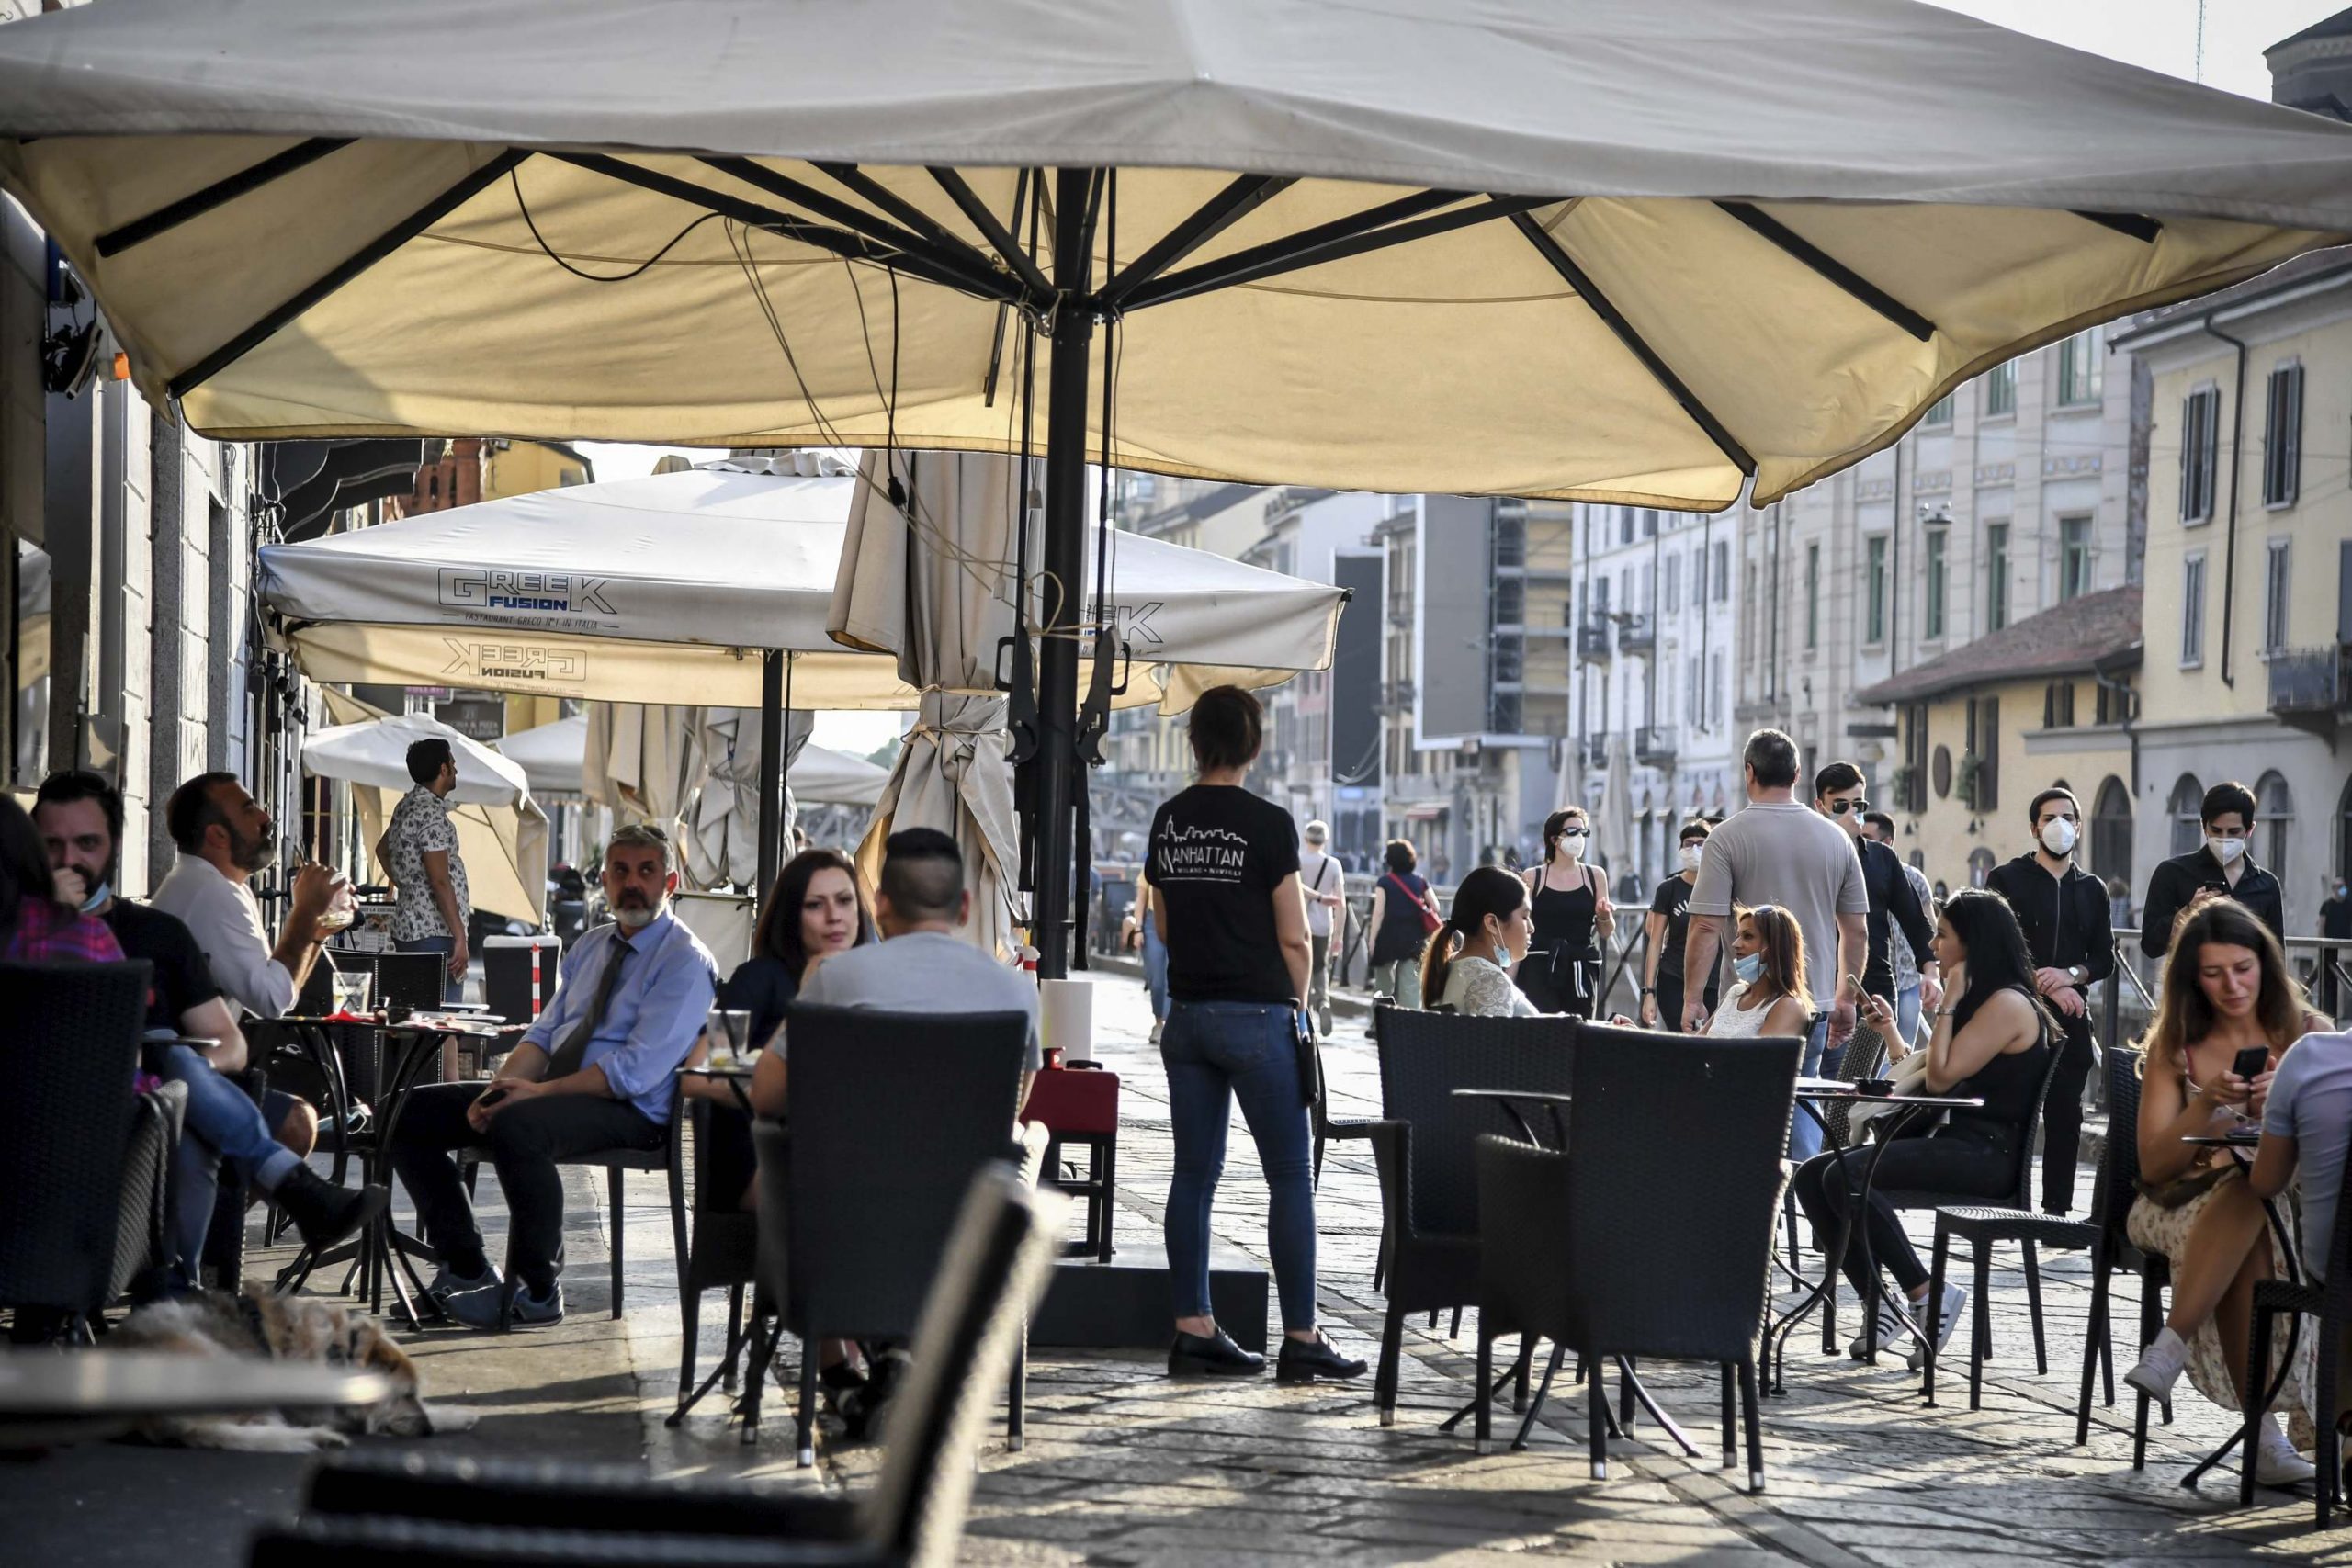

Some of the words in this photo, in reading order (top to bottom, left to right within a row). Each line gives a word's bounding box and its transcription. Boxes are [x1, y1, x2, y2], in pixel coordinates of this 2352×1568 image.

[438, 567, 617, 615] GREEK
[489, 595, 567, 611] FUSION
[517, 615, 541, 626] GRECO
[562, 618, 571, 628] IN
[573, 619, 598, 630] ITALIA
[1158, 846, 1245, 874] MANHATTAN
